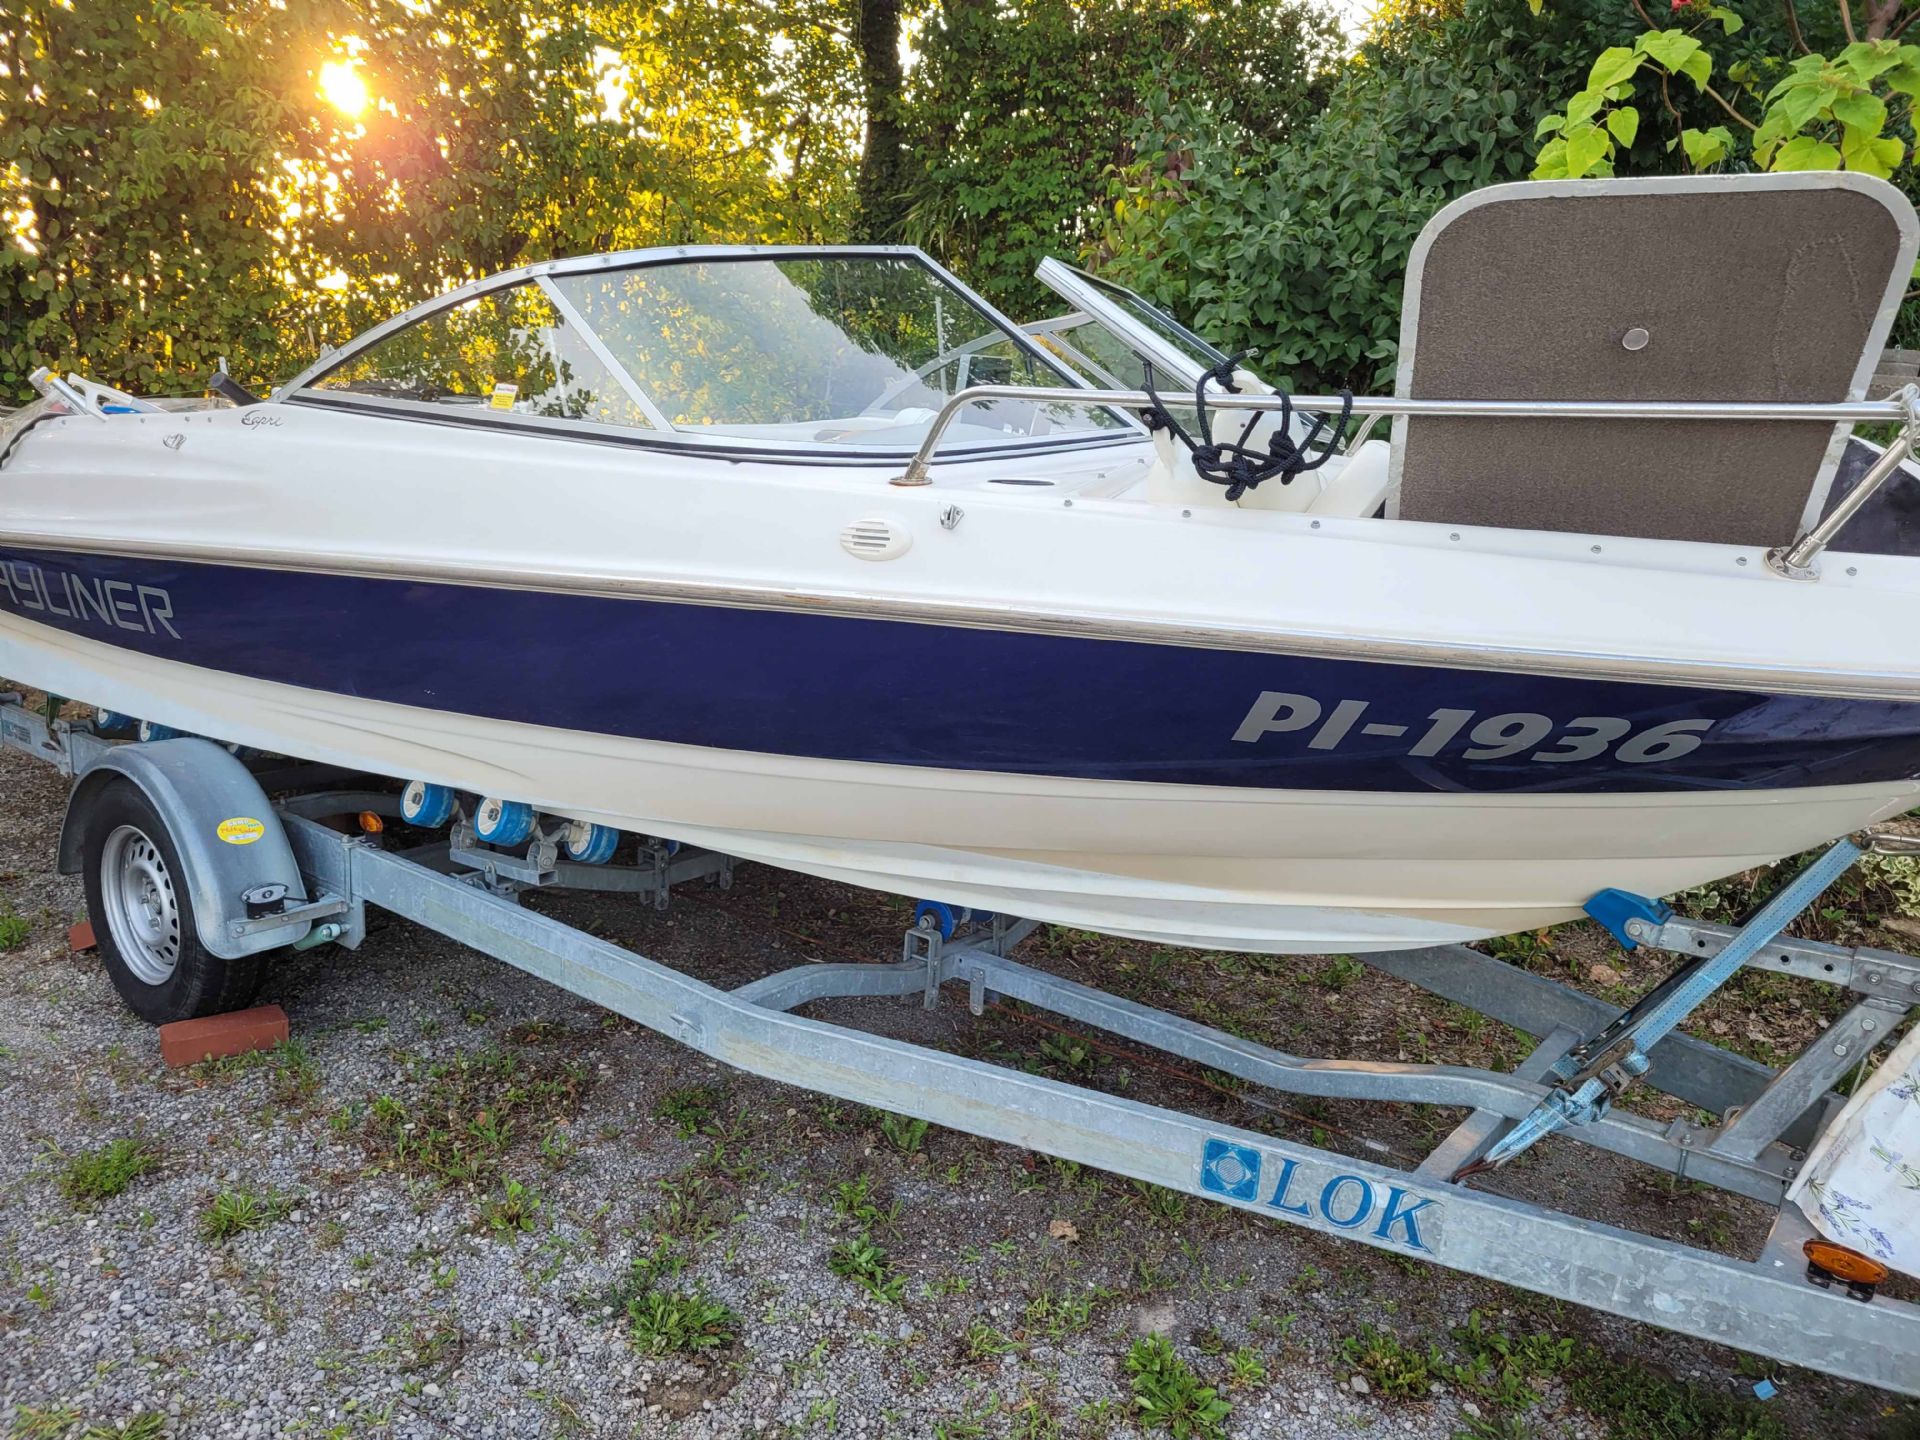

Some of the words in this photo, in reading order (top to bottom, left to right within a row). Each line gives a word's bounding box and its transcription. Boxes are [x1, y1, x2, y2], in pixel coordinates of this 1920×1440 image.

[241, 409, 284, 431] Capri
[1231, 691, 1716, 763] PI-1936
[1267, 1158, 1443, 1254] LOK
